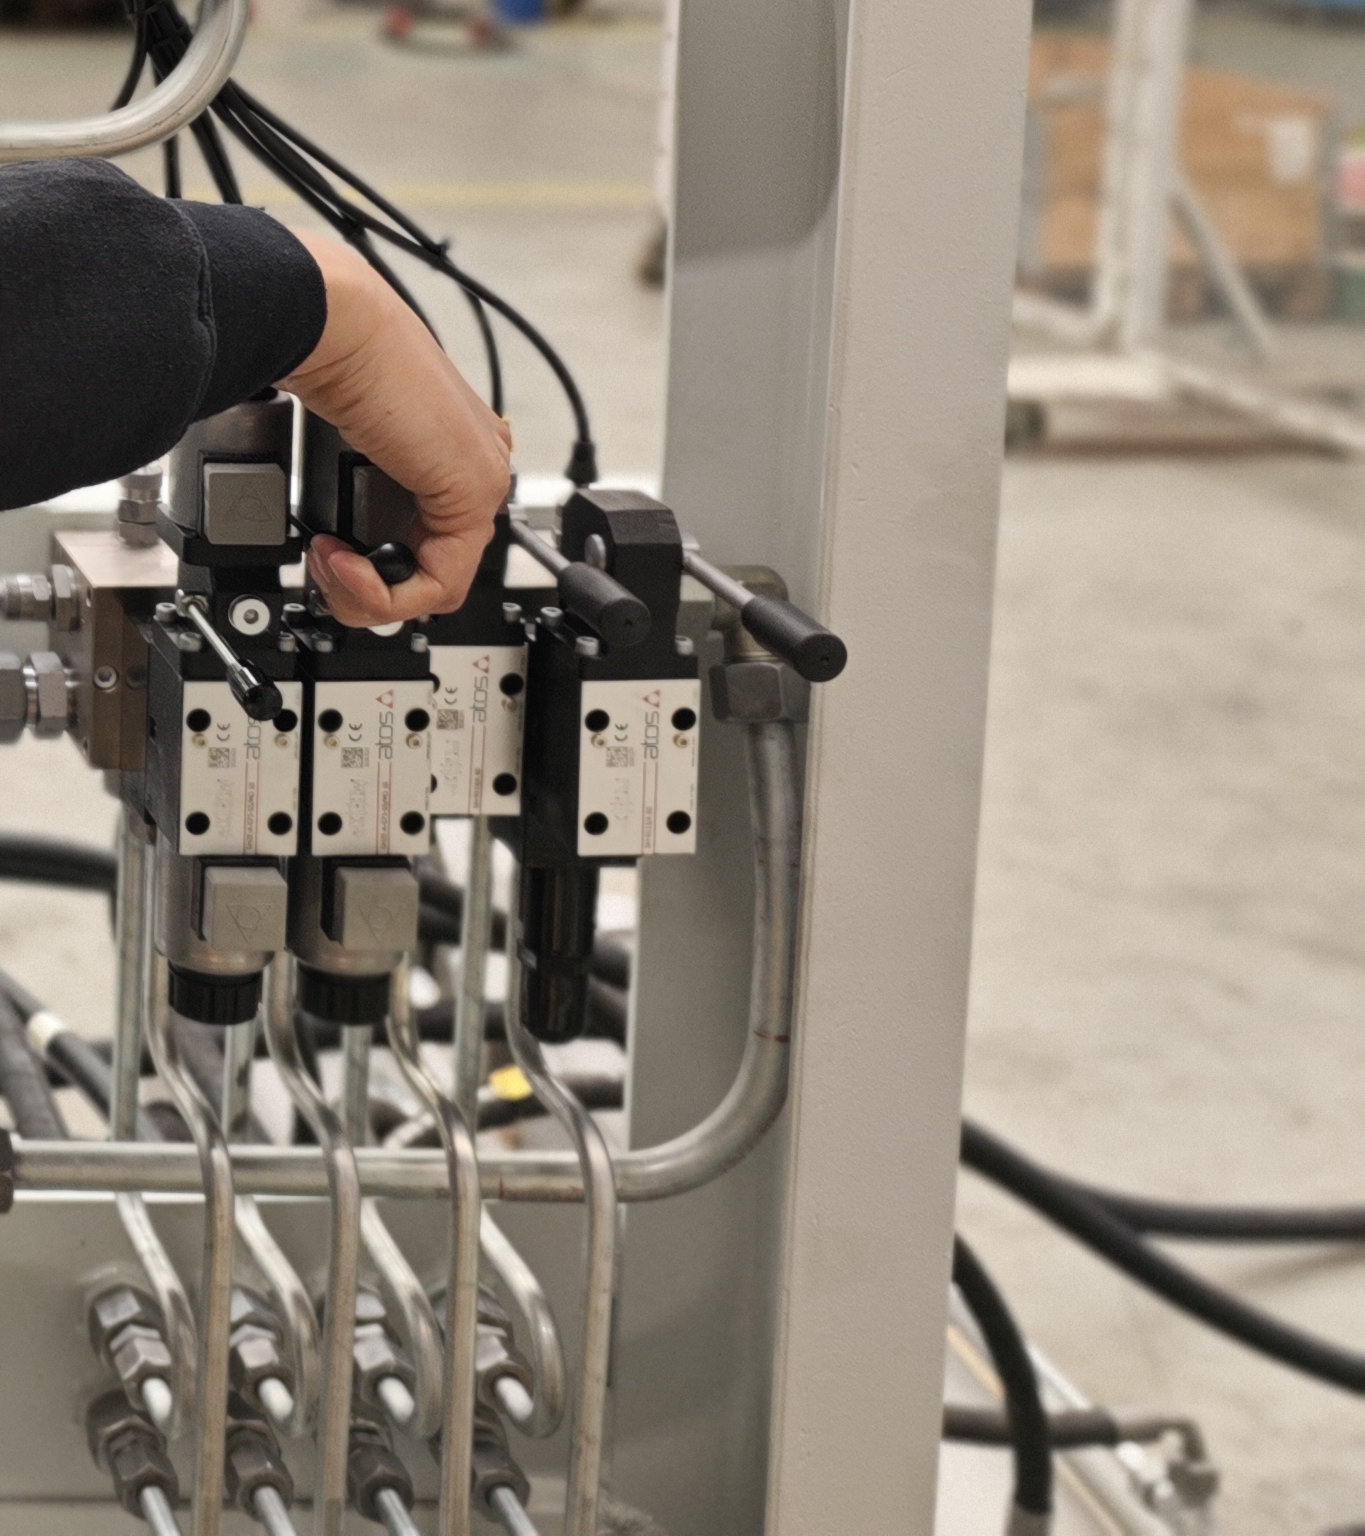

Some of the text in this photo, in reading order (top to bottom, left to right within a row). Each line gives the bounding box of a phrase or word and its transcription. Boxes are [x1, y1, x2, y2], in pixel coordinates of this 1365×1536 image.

[469, 676, 489, 723] atos
[374, 711, 394, 760] atos
[640, 711, 659, 760] atos
